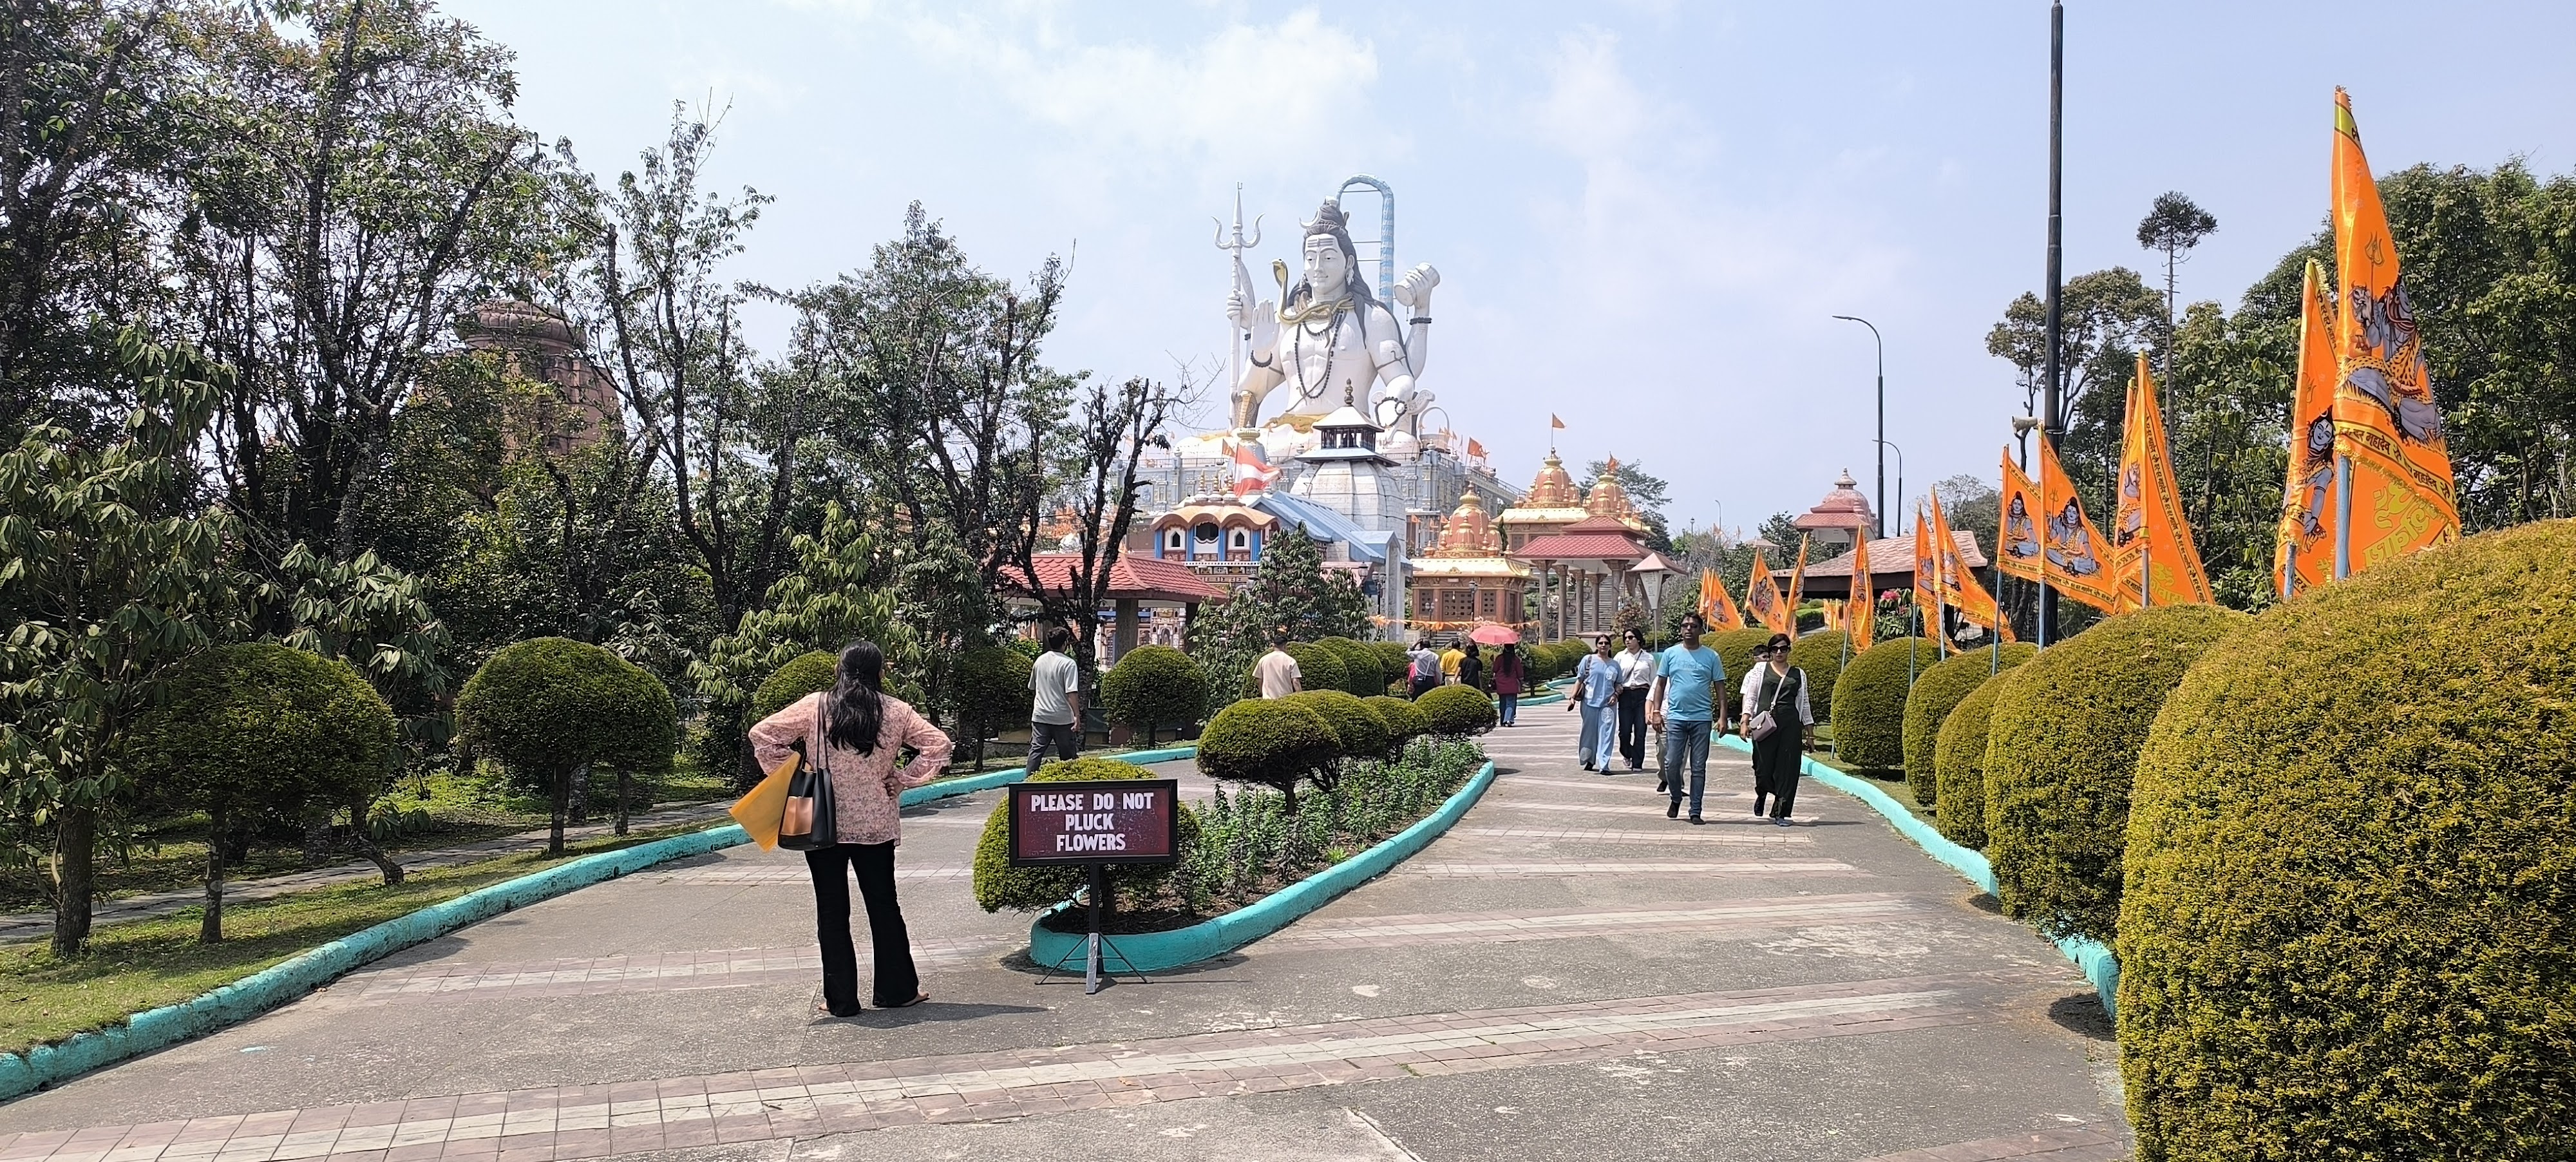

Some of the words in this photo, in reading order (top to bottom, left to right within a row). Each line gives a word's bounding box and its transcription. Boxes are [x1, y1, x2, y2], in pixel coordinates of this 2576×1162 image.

[2365, 432, 2392, 455] महादेव
[1031, 794, 1084, 812] PLEASE
[1093, 793, 1114, 810] DO
[1122, 792, 1154, 810] NOT
[1065, 814, 1115, 831] PLUCK
[1056, 833, 1126, 852] FLOWERS
